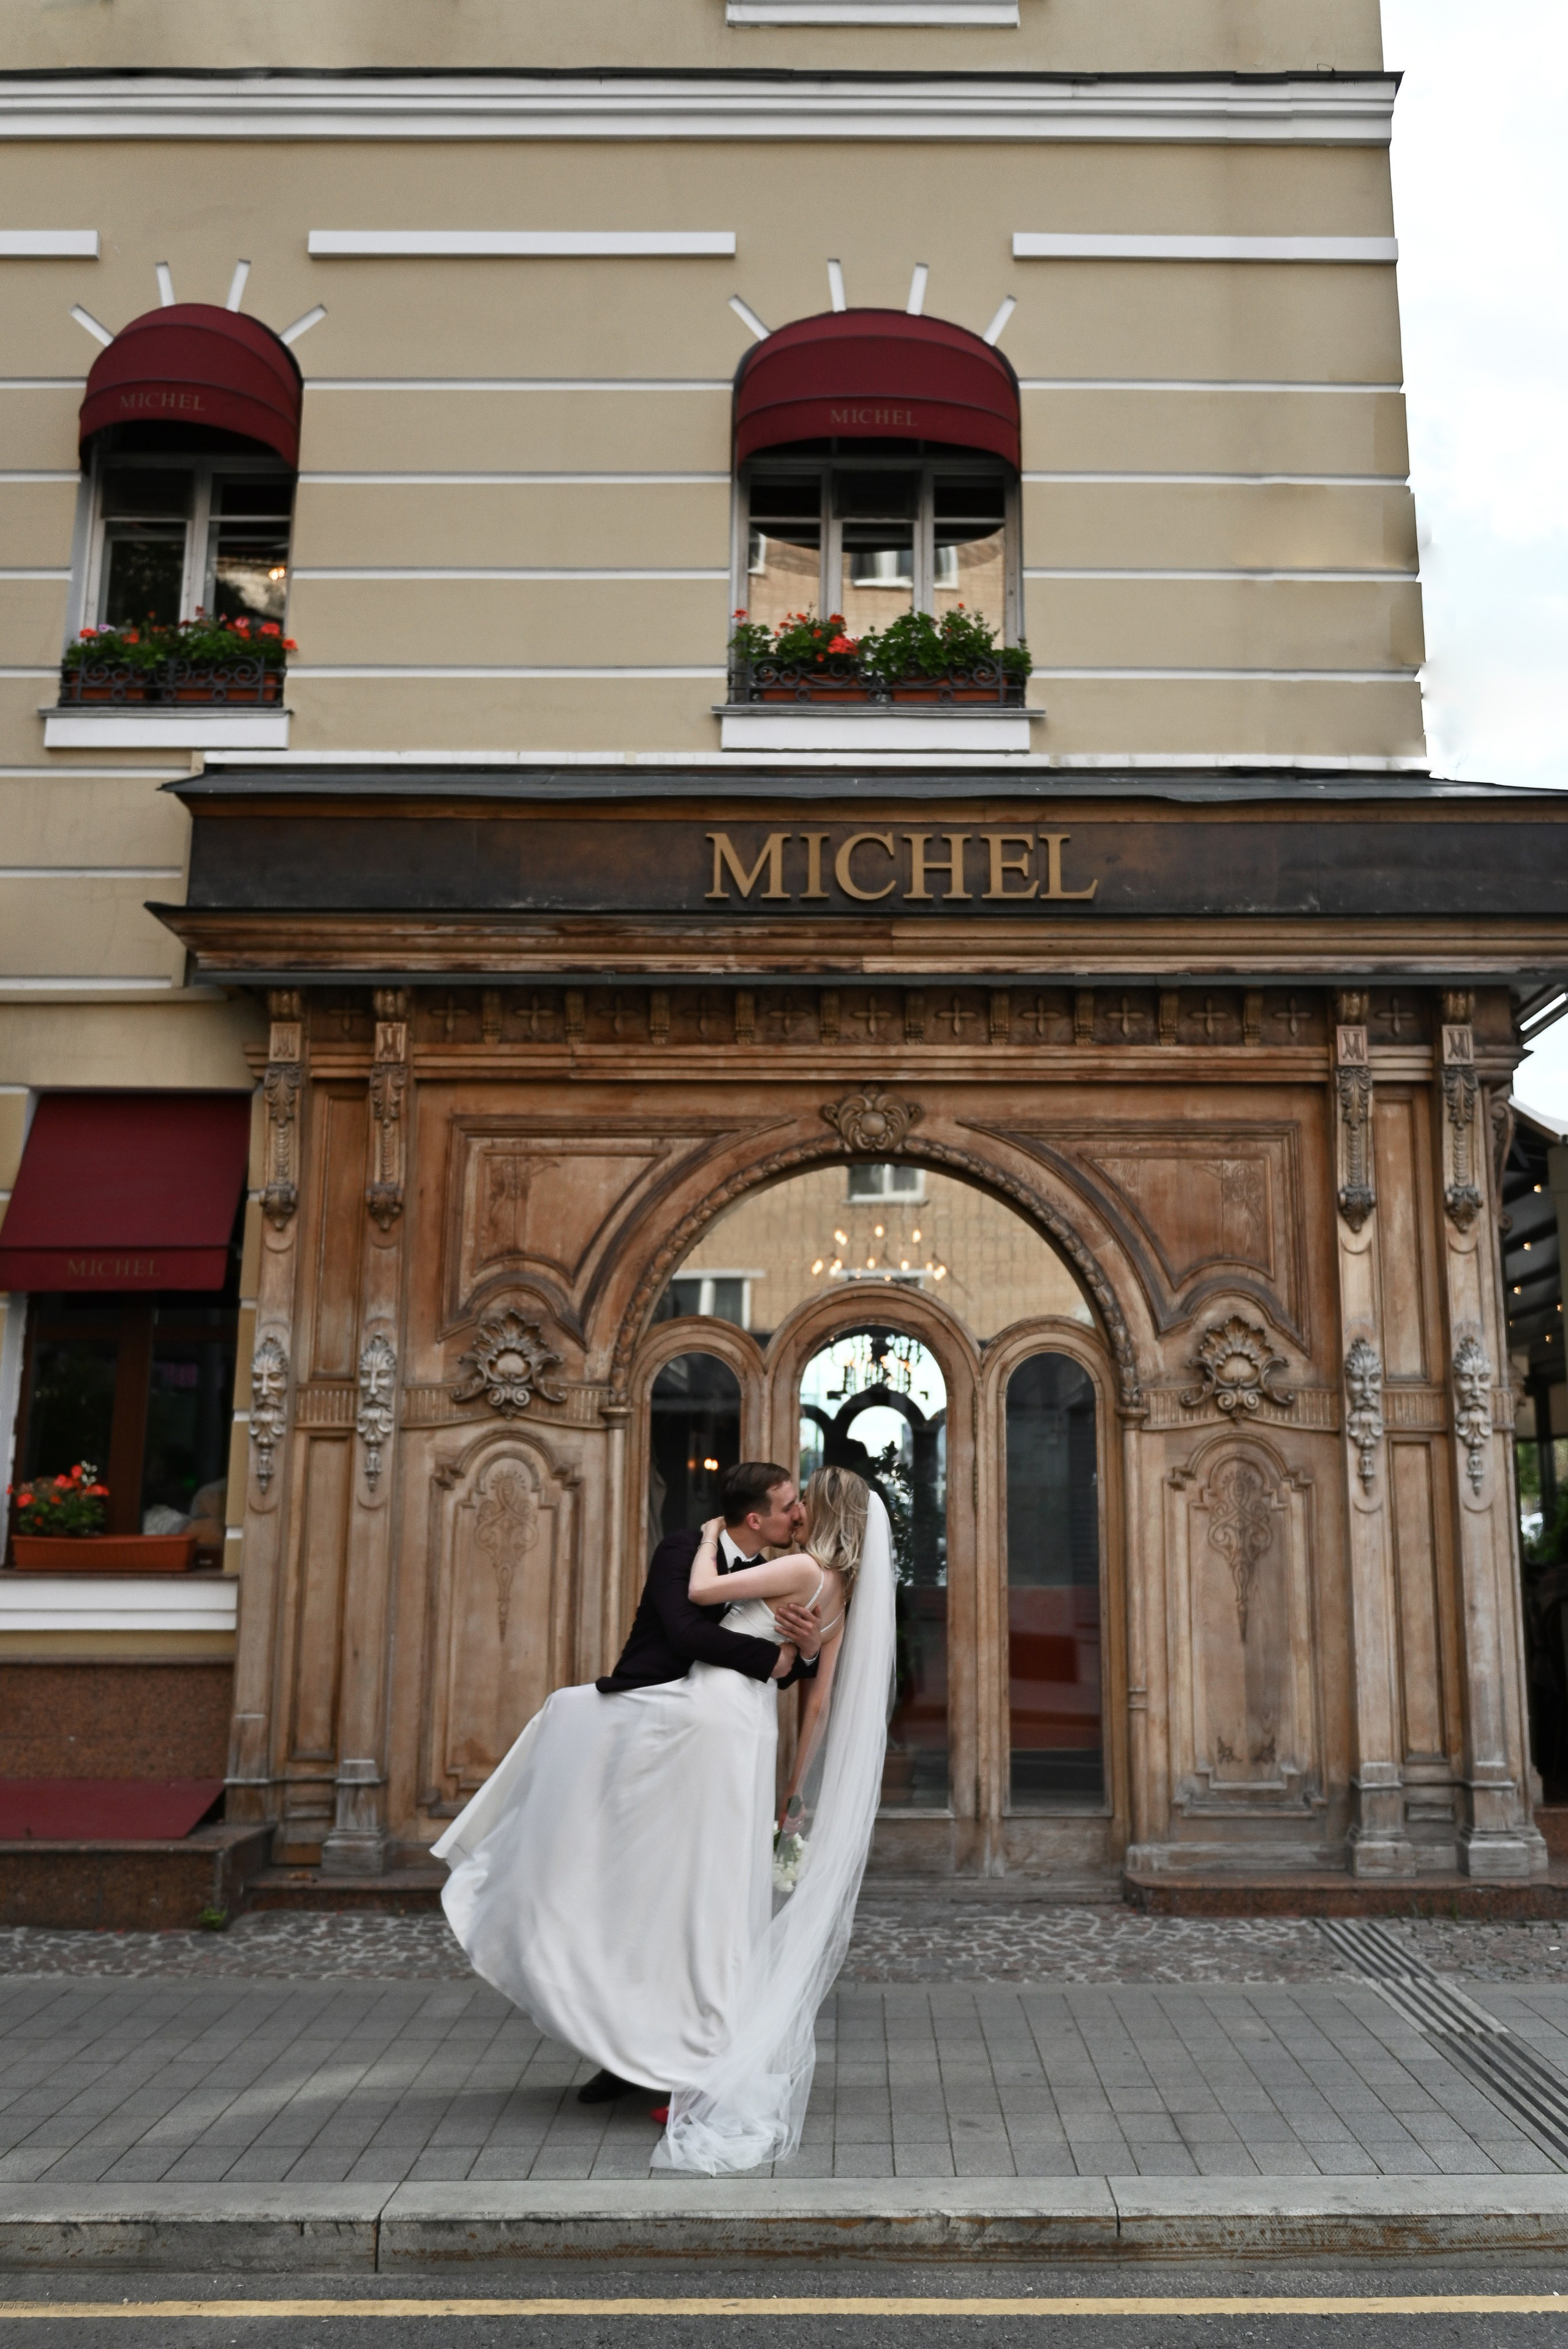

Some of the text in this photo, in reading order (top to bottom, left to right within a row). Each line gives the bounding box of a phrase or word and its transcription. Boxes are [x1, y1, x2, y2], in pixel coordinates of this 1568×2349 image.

[120, 393, 206, 411] MICHEL
[831, 409, 918, 426] MICHEL
[704, 832, 1099, 900] MICHEL
[1342, 1033, 1365, 1060] M
[1447, 1032, 1471, 1060] M
[67, 1259, 160, 1278] MICHEL
